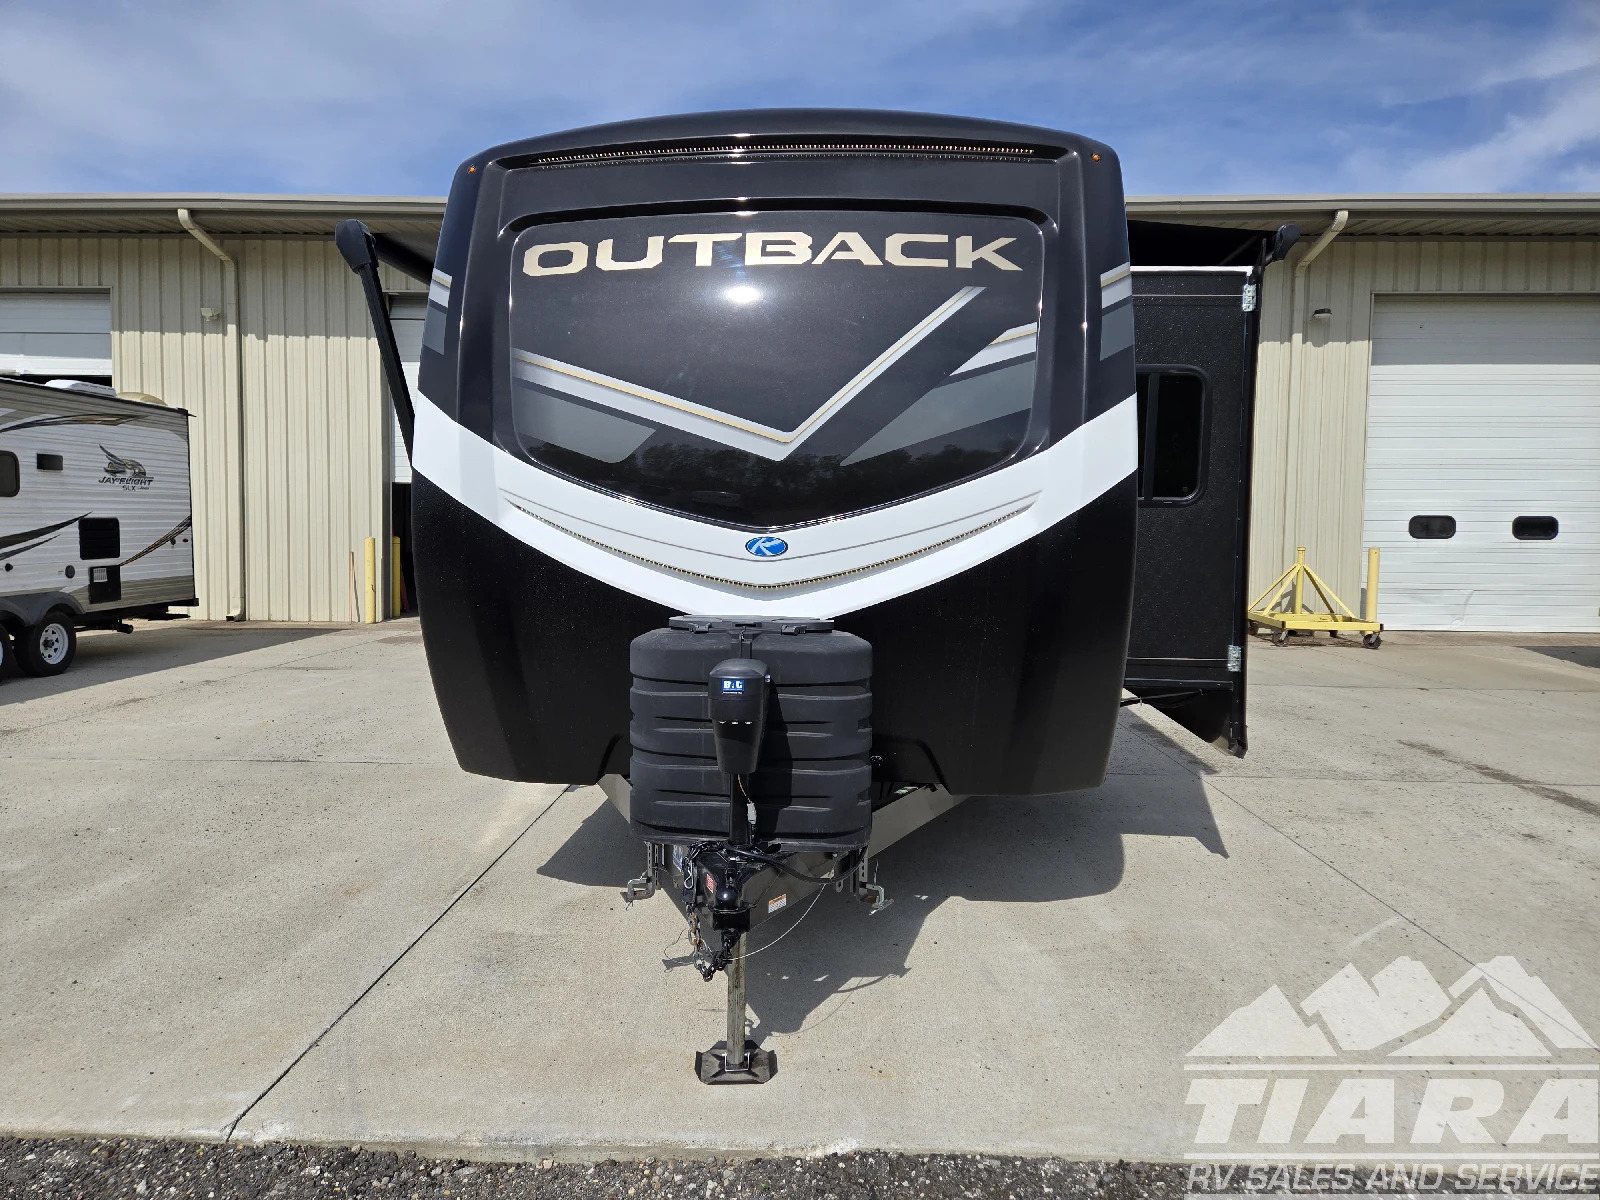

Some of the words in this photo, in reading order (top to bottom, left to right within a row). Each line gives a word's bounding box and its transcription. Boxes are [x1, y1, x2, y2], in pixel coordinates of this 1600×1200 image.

[522, 231, 1023, 277] OUTBACK
[98, 476, 118, 484] JAY
[119, 477, 154, 486] FLIGHT
